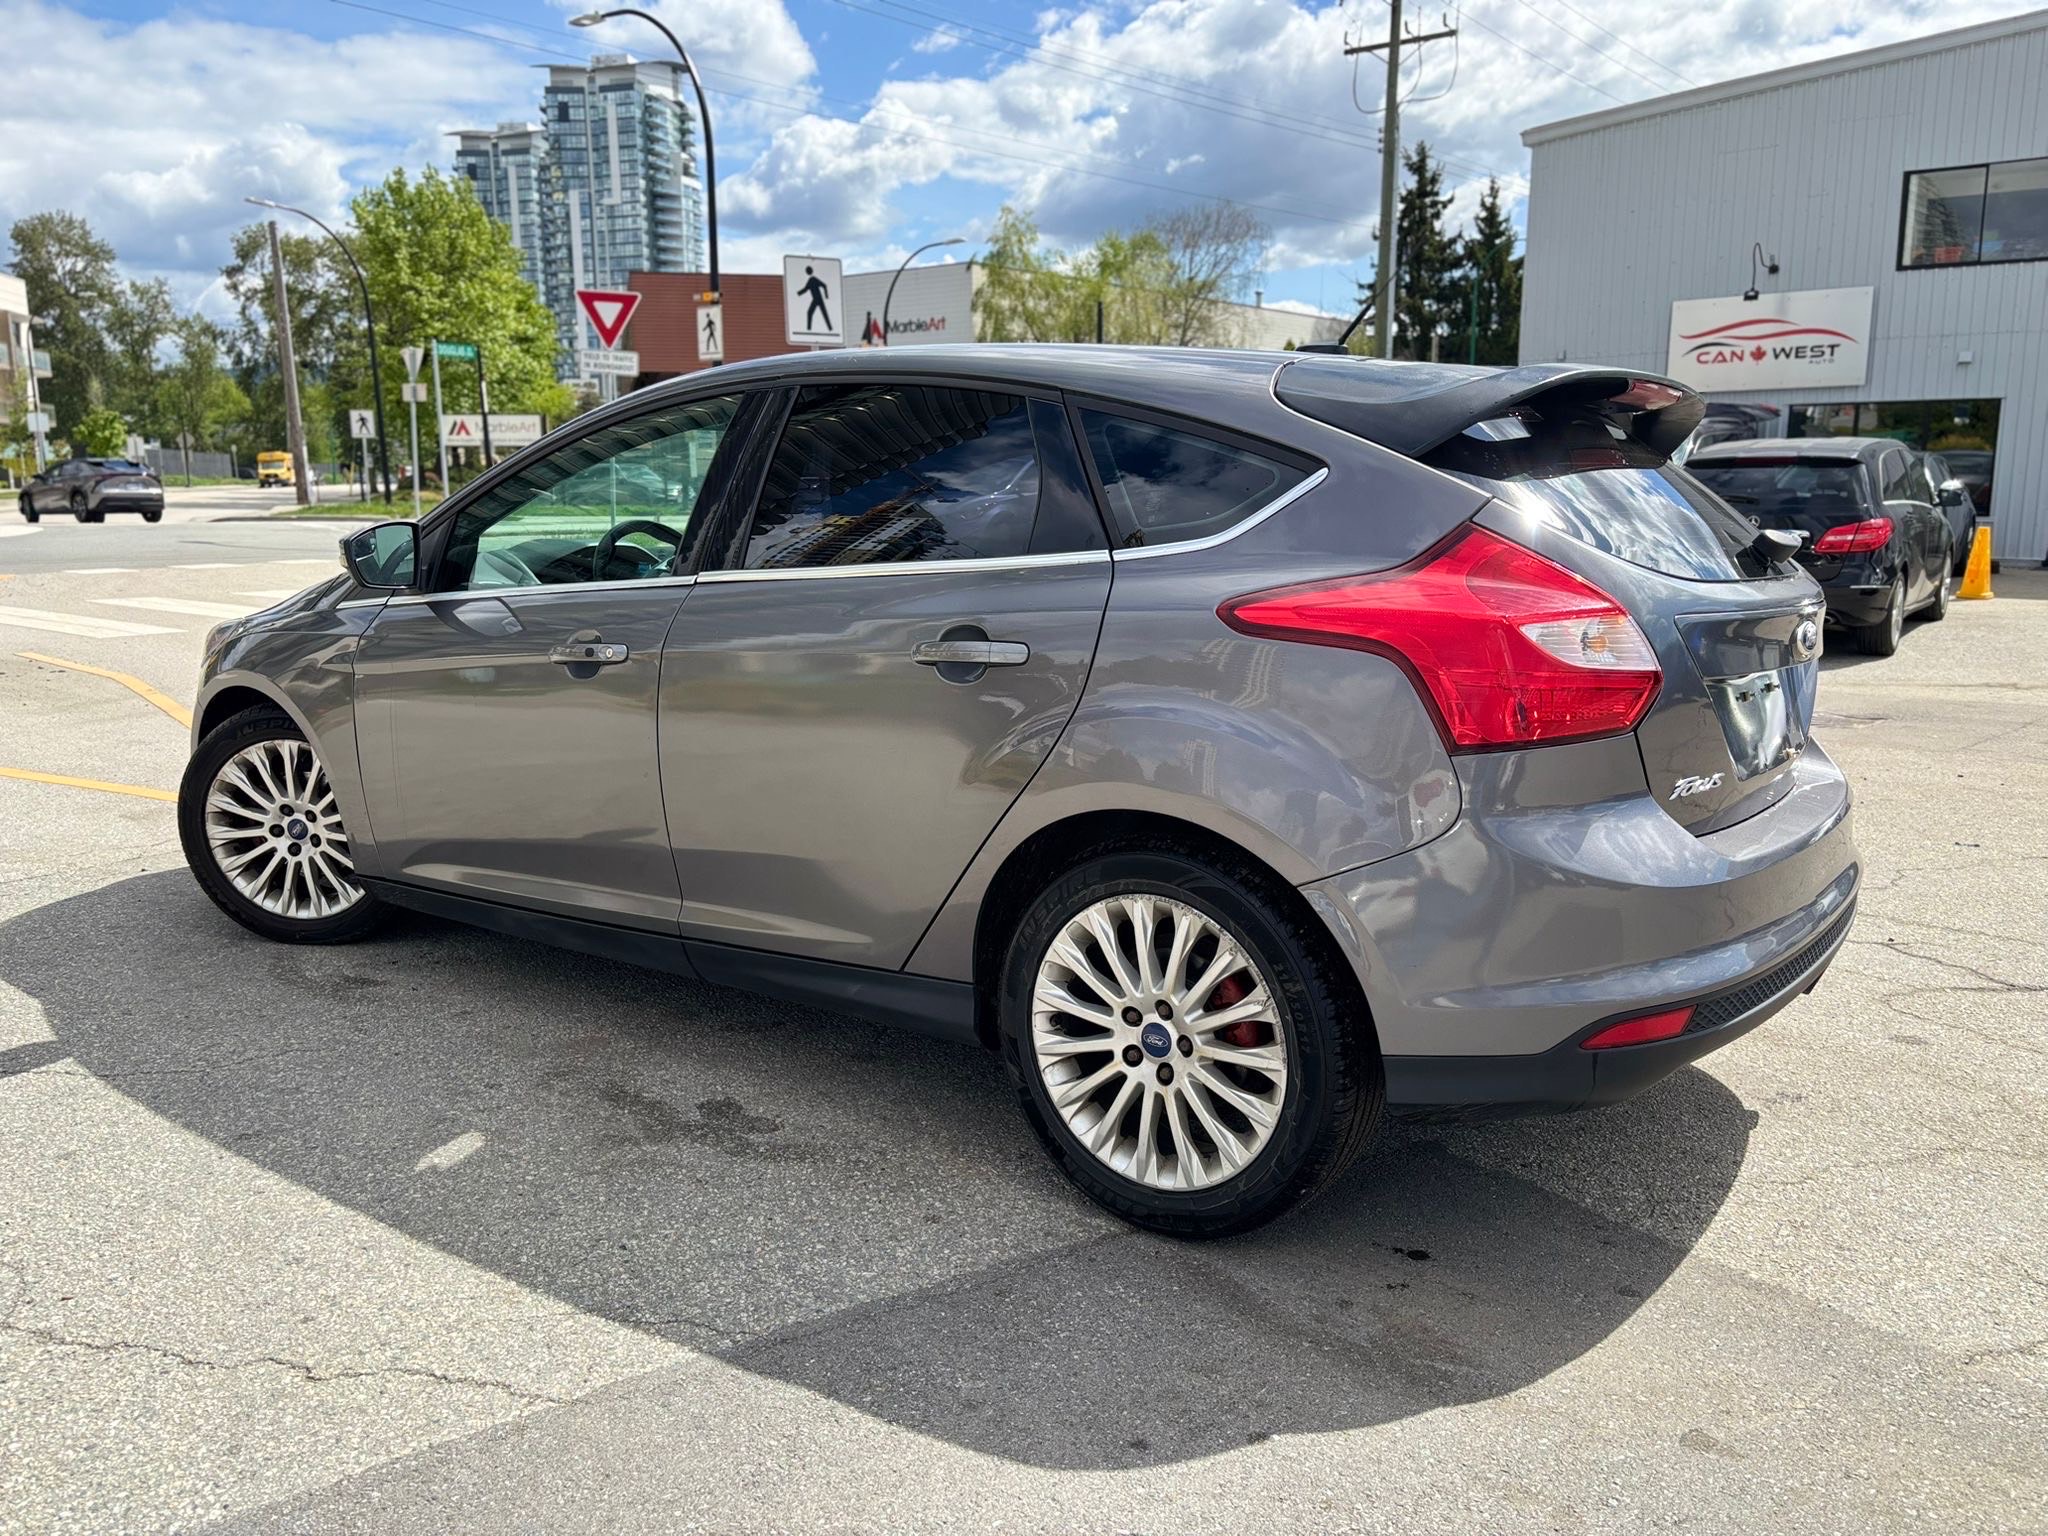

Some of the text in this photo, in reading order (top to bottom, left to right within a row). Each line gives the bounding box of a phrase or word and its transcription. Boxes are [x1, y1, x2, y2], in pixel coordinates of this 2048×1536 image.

[1696, 344, 1841, 364] CAN WEST
[1668, 772, 1726, 801] Focus
